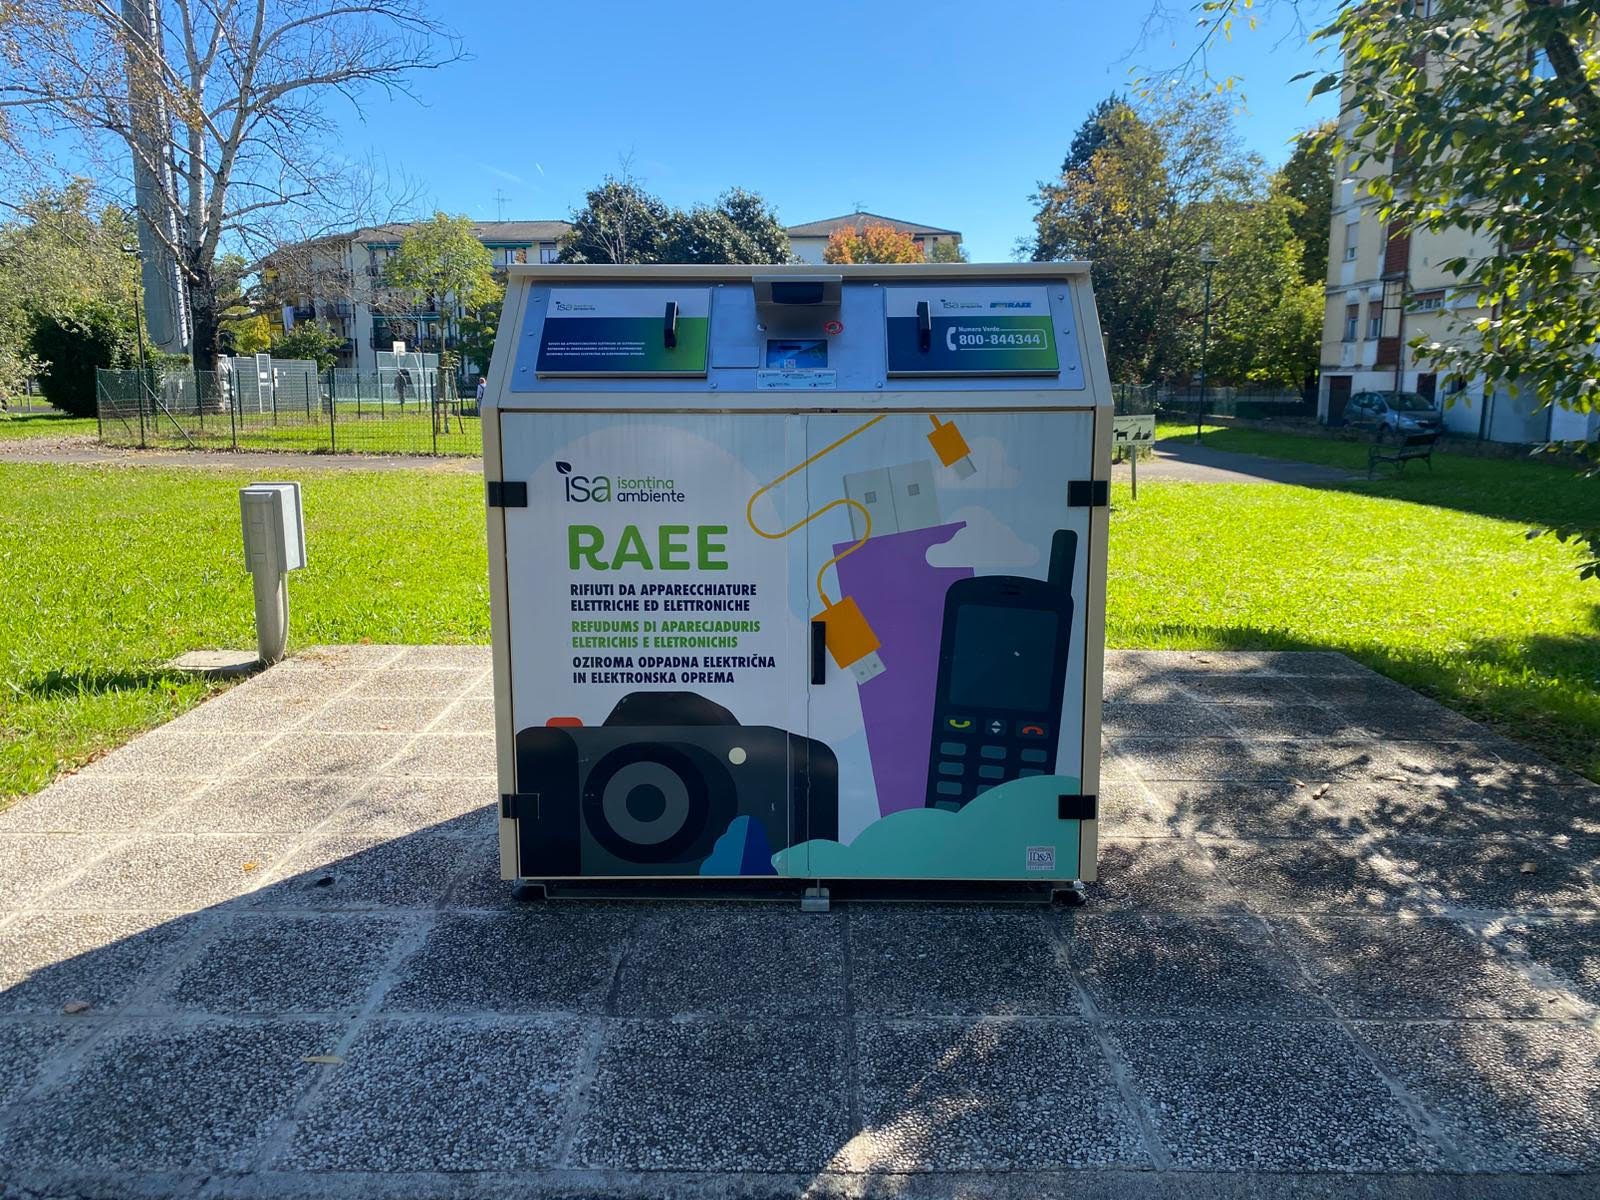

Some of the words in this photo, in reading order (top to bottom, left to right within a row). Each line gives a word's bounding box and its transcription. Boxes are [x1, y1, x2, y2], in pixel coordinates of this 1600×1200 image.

[959, 334, 1041, 345] 800-844344
[555, 461, 612, 503] isa
[617, 476, 674, 489] isontina
[617, 489, 686, 503] ambiente
[568, 524, 729, 571] RAEE
[570, 584, 614, 596] RIFIUTI
[618, 584, 636, 596] DA
[640, 584, 757, 596] APPARECCHIATURE
[571, 600, 640, 612] ELETTRICHE
[644, 600, 659, 611] ED
[664, 600, 750, 611] ELETTRONICHE
[571, 621, 639, 633] REFUDUMS
[643, 621, 657, 632] DI
[661, 621, 761, 632] APARECJADURIS
[572, 636, 639, 648] ELETRICHIS
[643, 636, 650, 648] E
[654, 636, 738, 648] ELETRONICHIS
[572, 656, 634, 669] OZIROMA
[638, 656, 699, 668] ODPADNA
[703, 653, 776, 668] ELEKTRIČNA
[573, 672, 587, 684] IN
[591, 672, 677, 684] ELEKTRONSKA
[681, 672, 735, 683] OPREMA
